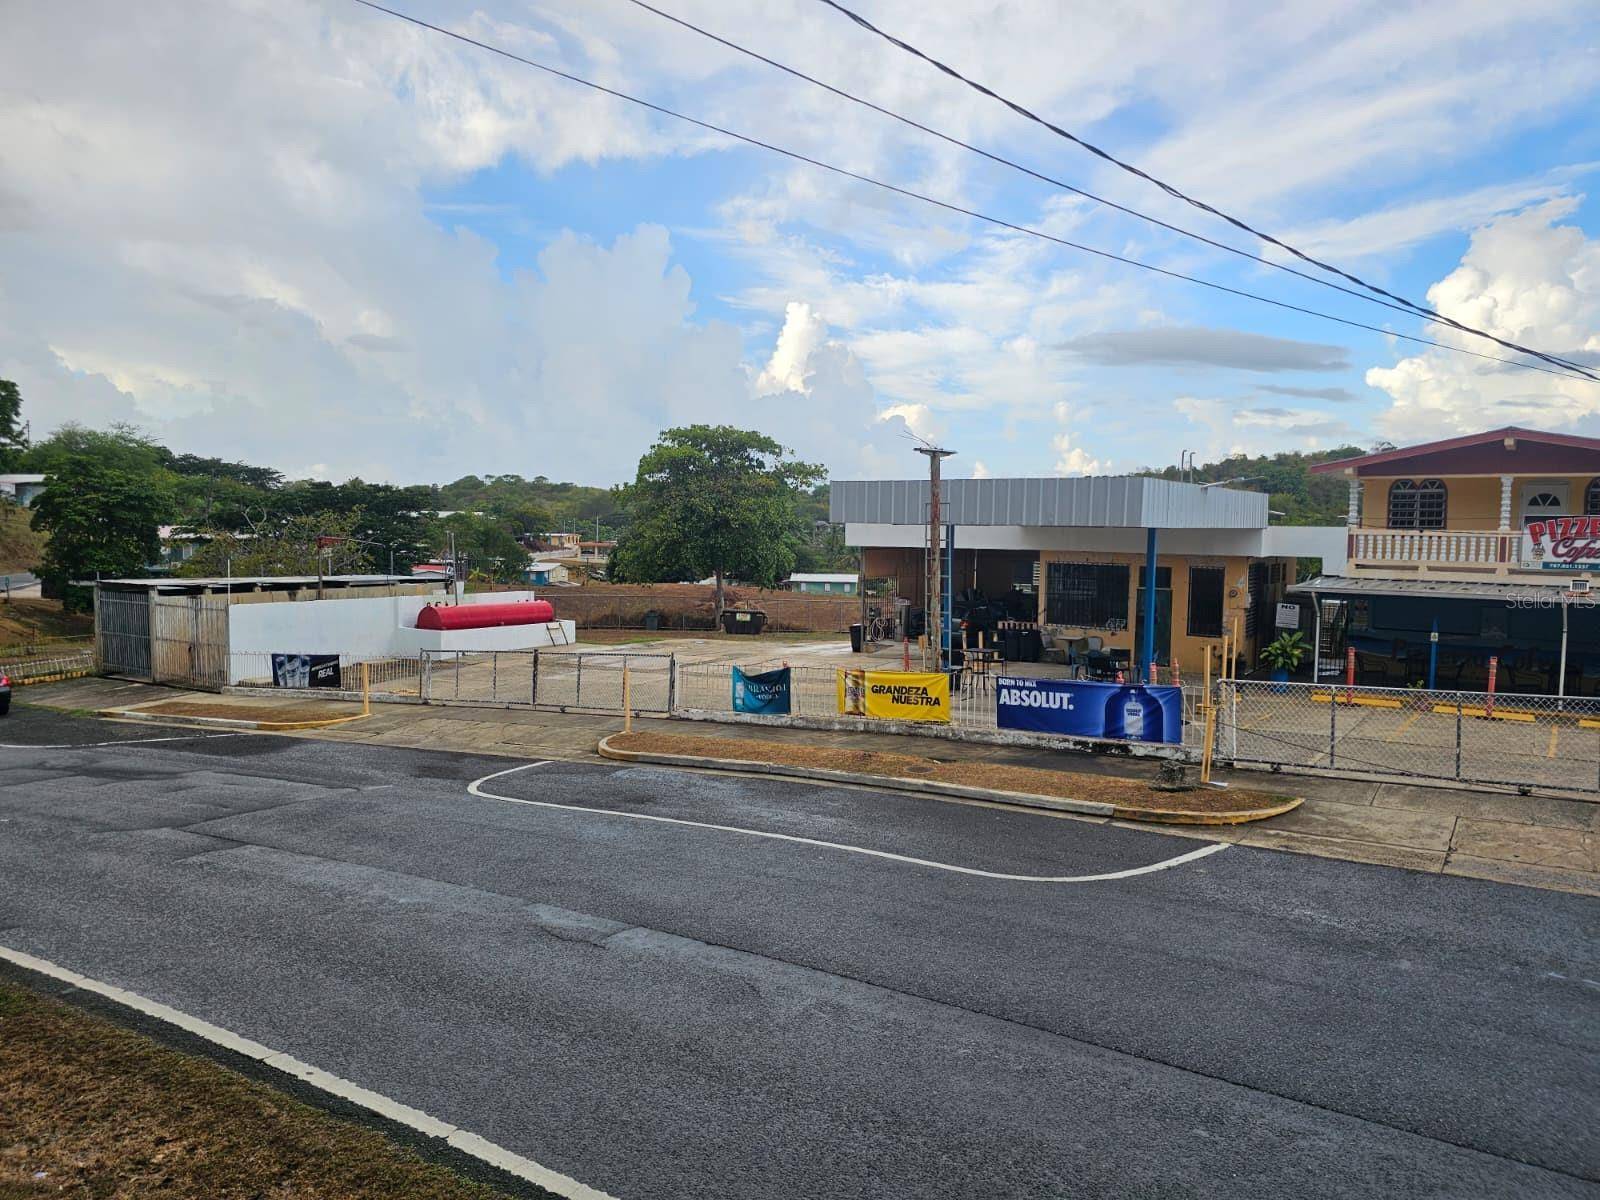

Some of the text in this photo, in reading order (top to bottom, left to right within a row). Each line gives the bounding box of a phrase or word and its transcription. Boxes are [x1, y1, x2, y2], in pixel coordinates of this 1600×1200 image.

[998, 678, 1016, 687] BORN
[1016, 679, 1024, 687] TO
[871, 684, 929, 697] GRANDEZA
[891, 695, 941, 707] NUESTRA
